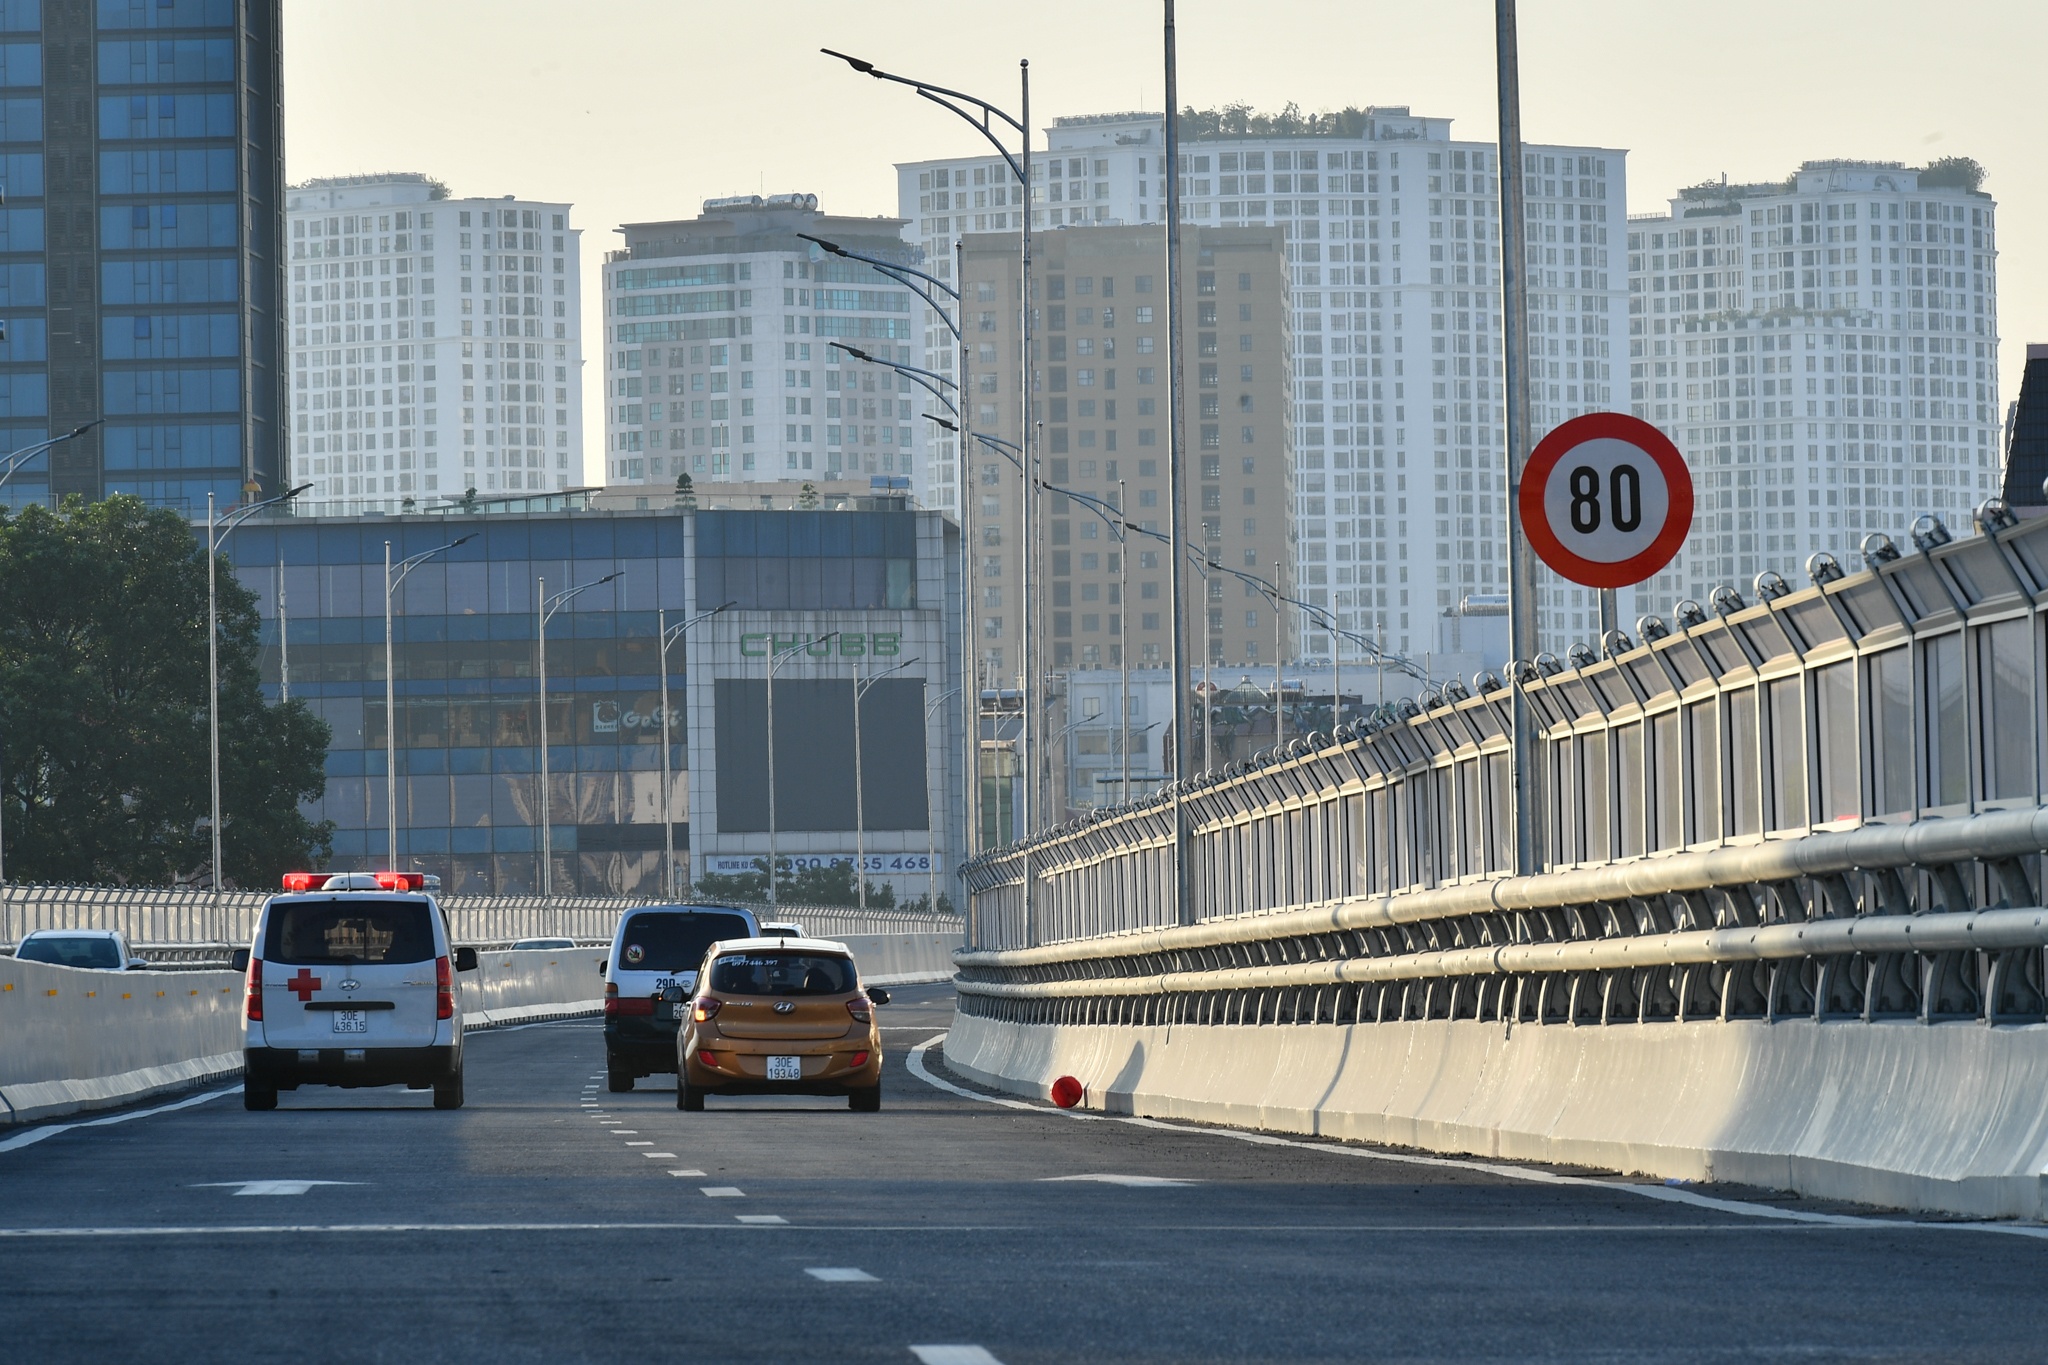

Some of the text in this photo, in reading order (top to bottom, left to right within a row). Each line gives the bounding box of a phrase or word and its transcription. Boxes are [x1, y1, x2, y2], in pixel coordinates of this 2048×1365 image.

[1570, 464, 1641, 534] 80
[741, 632, 900, 657] CHUBB
[890, 857, 930, 870] 468
[341, 1010, 358, 1021] 30E
[334, 1021, 365, 1031] 436.15
[775, 1057, 793, 1067] 30E
[769, 1068, 800, 1079] 193.48
